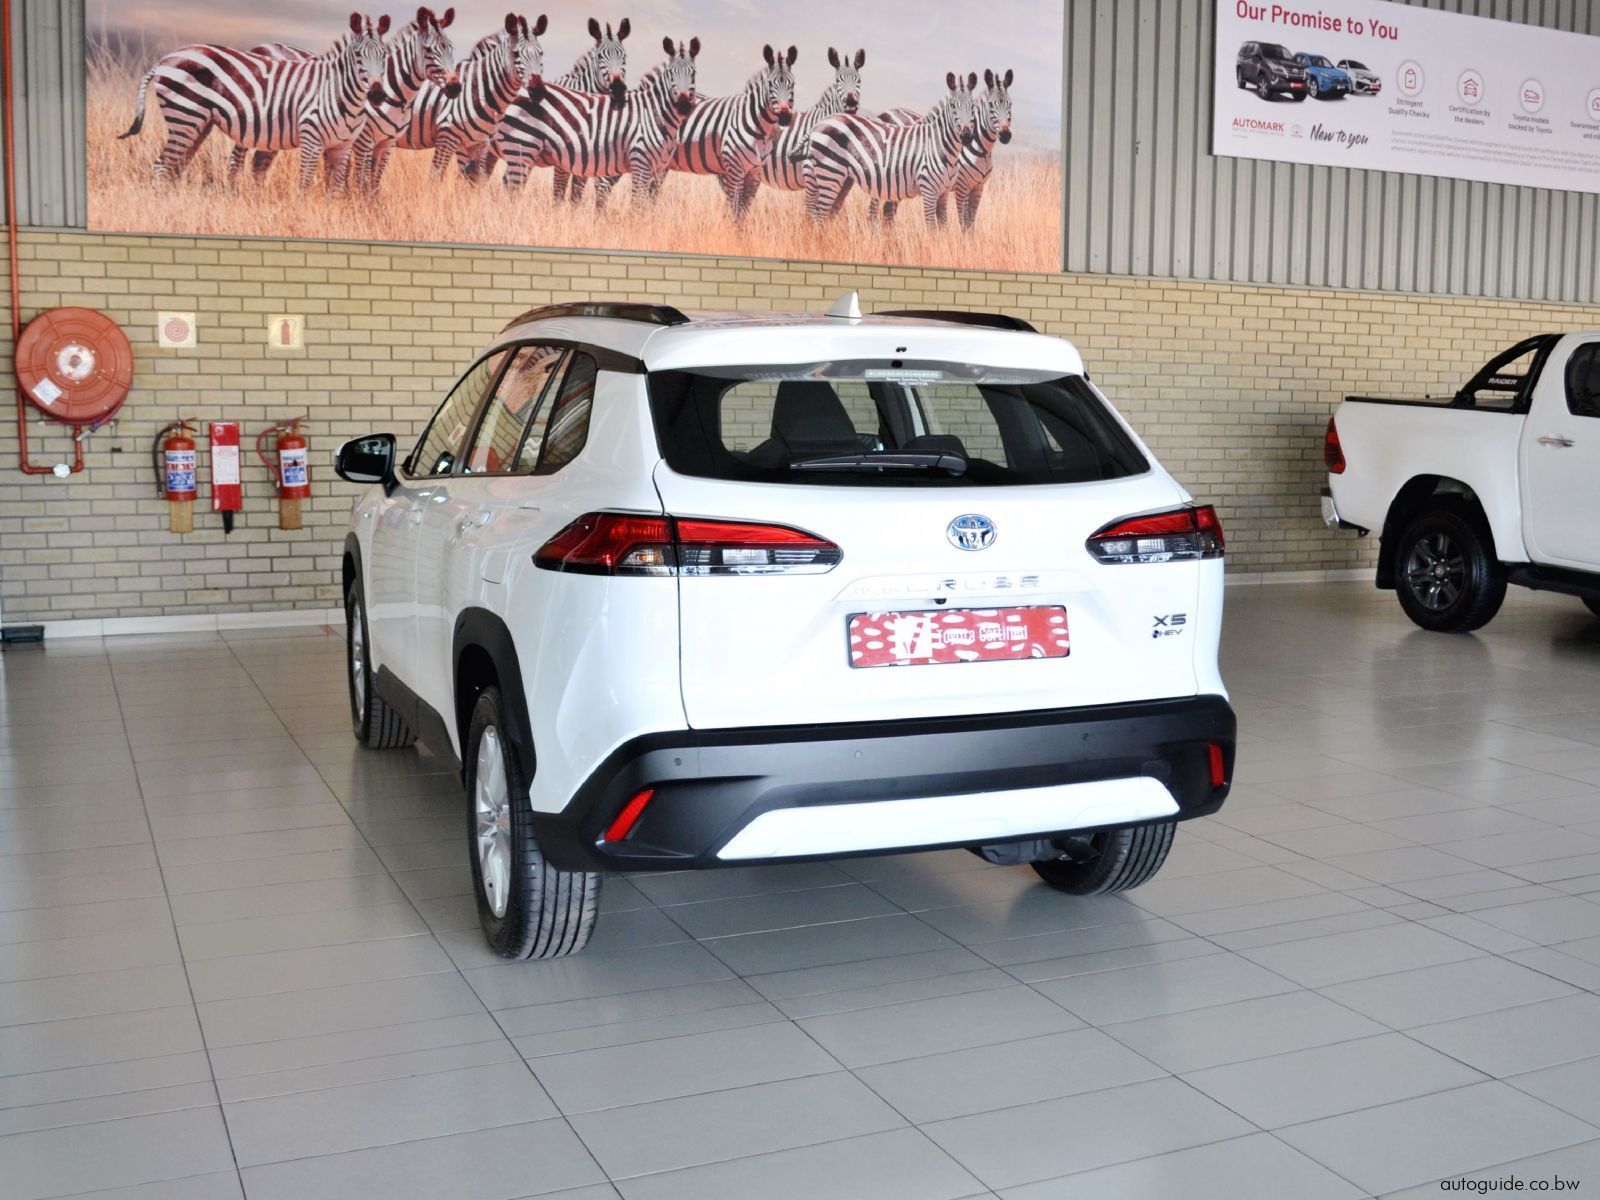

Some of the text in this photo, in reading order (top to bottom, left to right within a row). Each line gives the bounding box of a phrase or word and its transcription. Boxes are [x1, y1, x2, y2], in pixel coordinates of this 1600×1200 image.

[1236, 0, 1398, 40] Our Promise to You
[1396, 98, 1423, 108] Stringent
[1388, 107, 1430, 118] Quality Checks
[1448, 105, 1483, 116] Certification
[1454, 115, 1485, 126] the dealers
[1513, 113, 1550, 125] Toyota models
[1232, 118, 1285, 132] AUTOMARK
[1508, 123, 1528, 132] backed
[1536, 126, 1553, 135] Toyota
[1570, 120, 1600, 131] Guaranteed
[1310, 123, 1369, 149] New to you
[1488, 377, 1518, 385] RAIDER
[1153, 613, 1187, 628] X5
